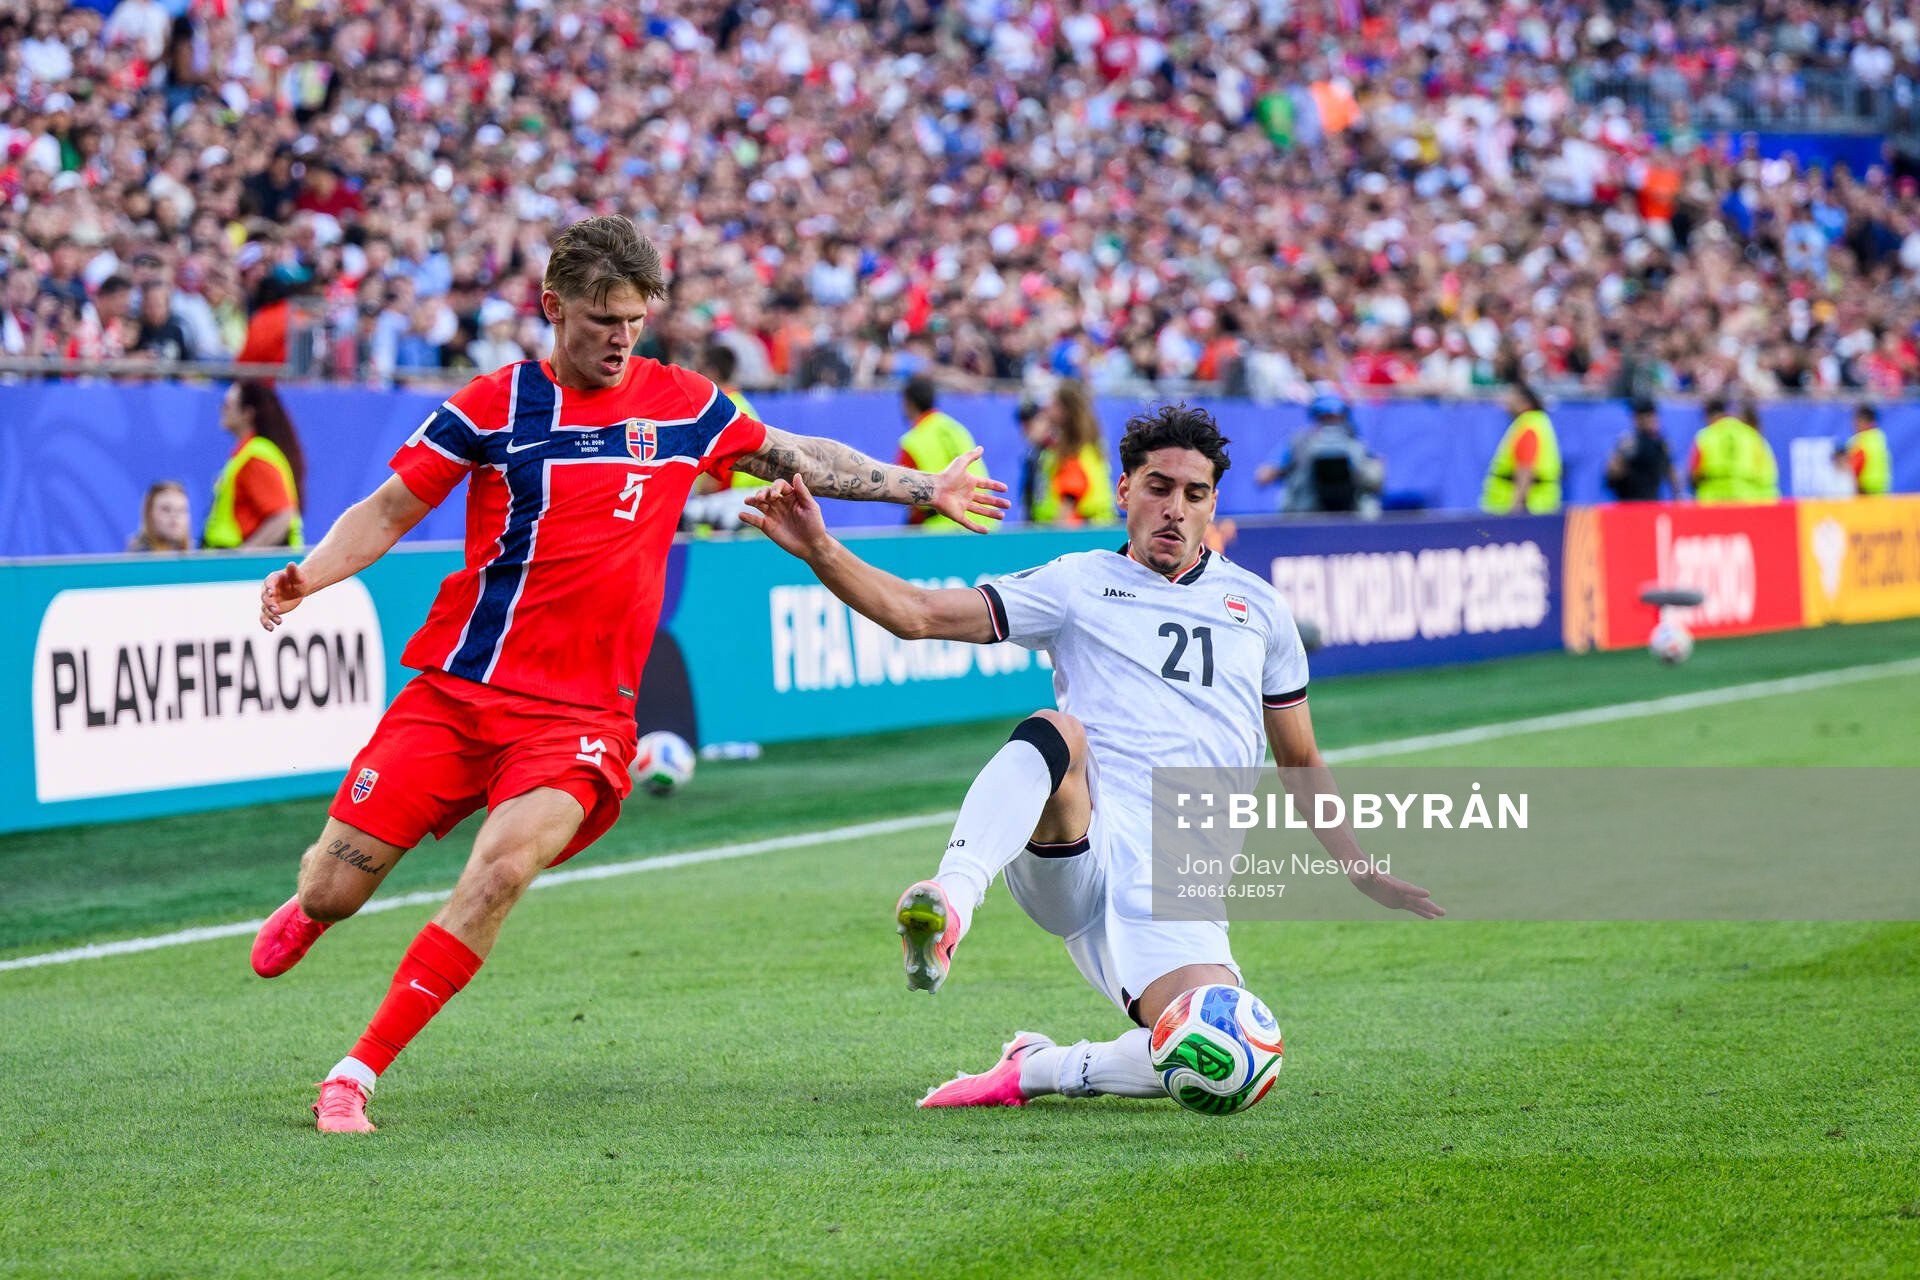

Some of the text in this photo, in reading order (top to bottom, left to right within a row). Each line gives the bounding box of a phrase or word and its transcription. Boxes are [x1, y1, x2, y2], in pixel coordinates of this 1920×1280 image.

[613, 472, 652, 521] 5
[51, 631, 368, 731] PLAY.FIFA.COM
[1158, 622, 1214, 687] 21
[576, 736, 607, 766] 5
